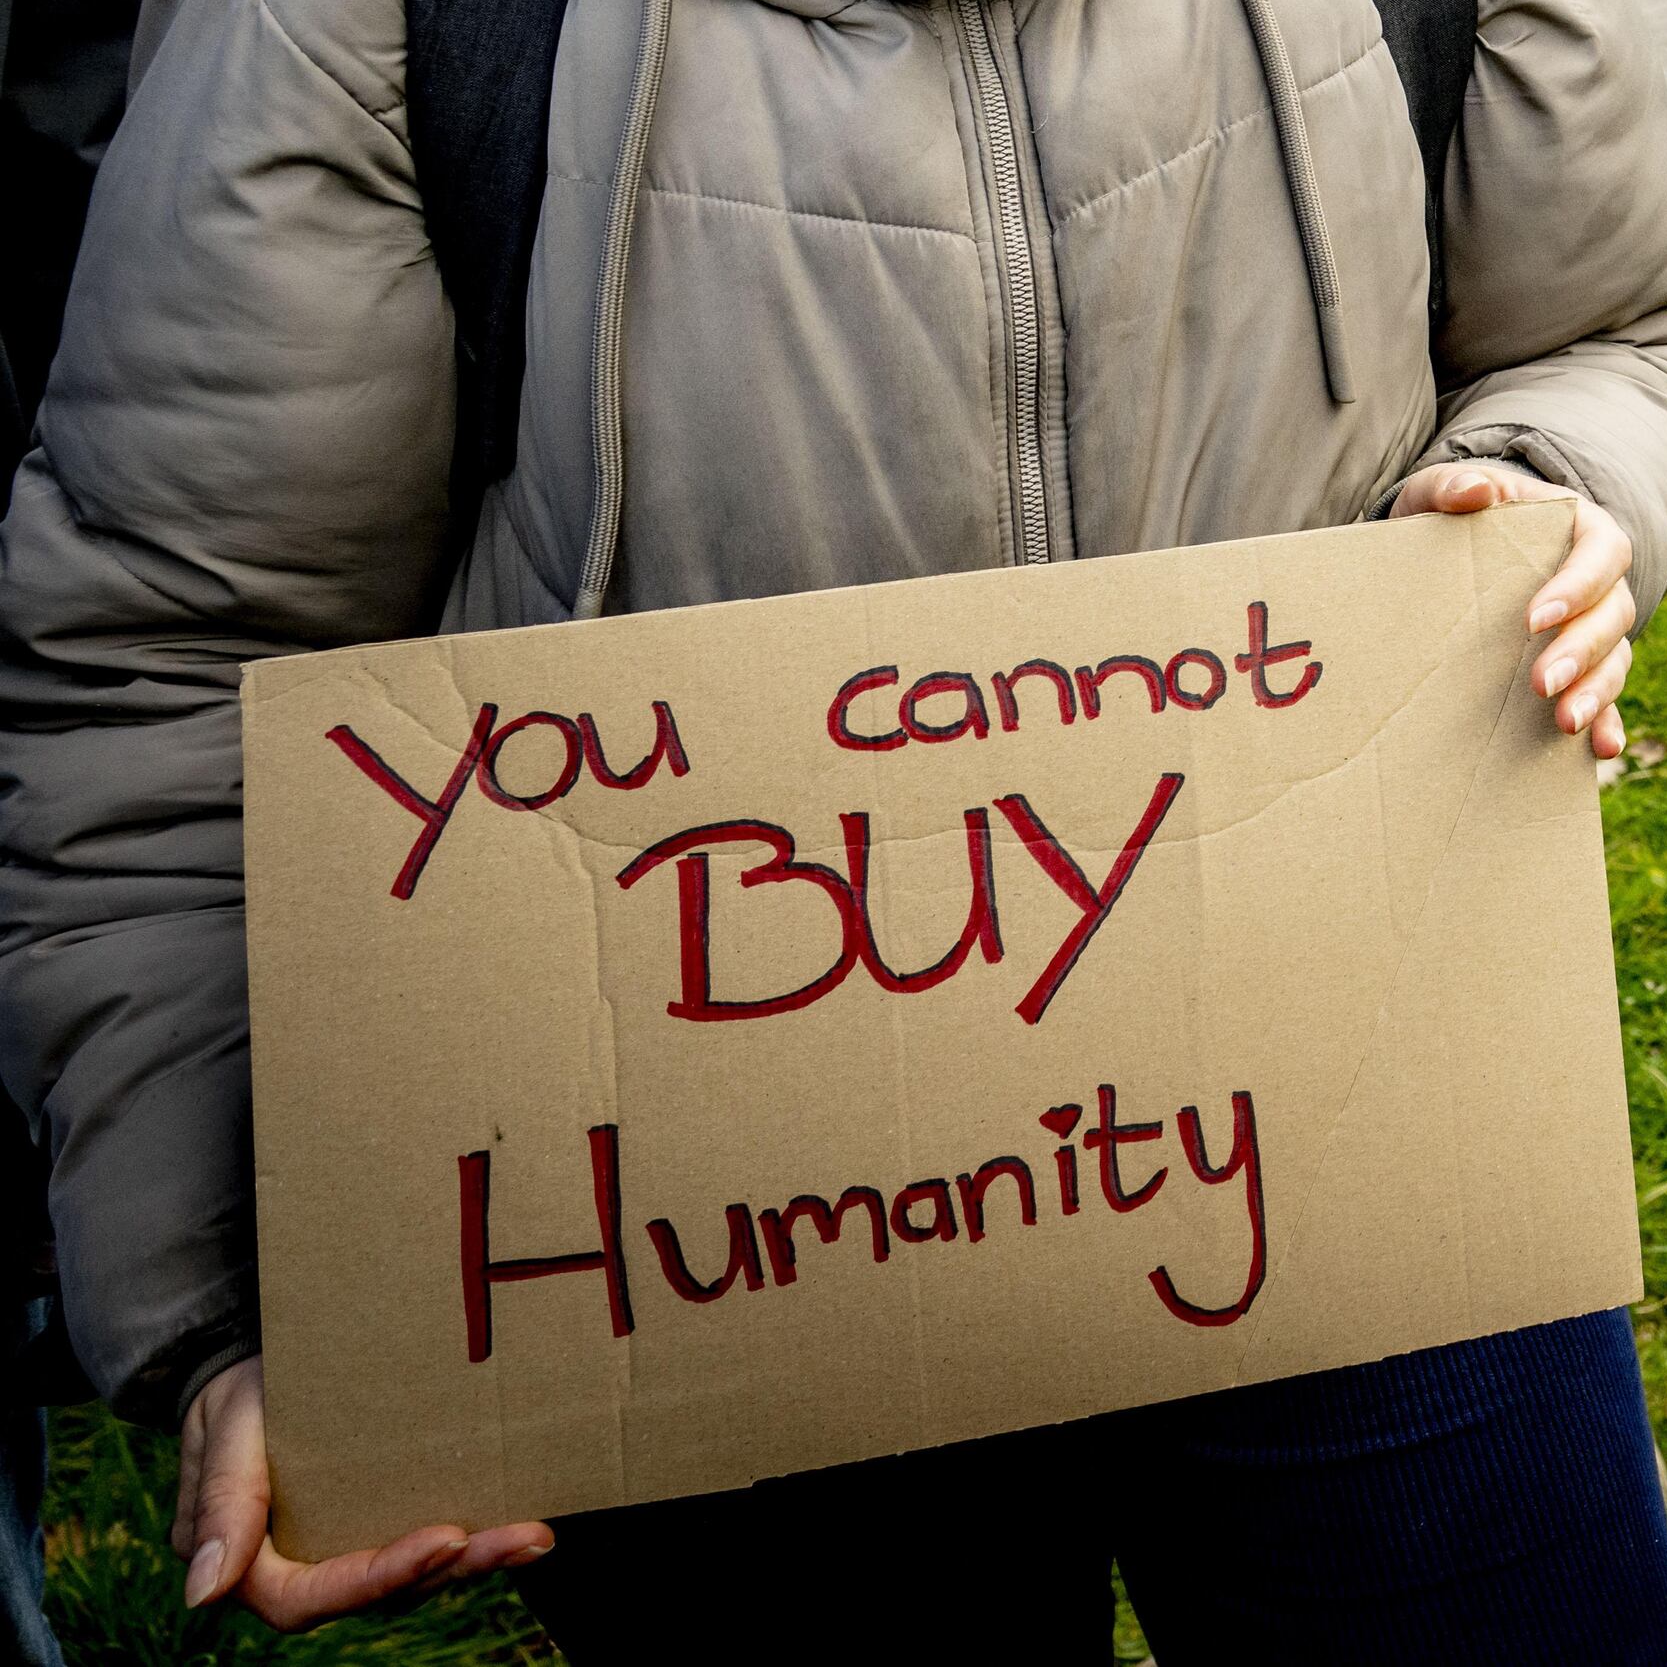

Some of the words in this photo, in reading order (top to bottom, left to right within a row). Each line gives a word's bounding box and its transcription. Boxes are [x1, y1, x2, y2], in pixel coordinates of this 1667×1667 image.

[827, 600, 1322, 751] cannot
[615, 772, 1185, 1024] BUY
[459, 1084, 1265, 1363] Humanity
